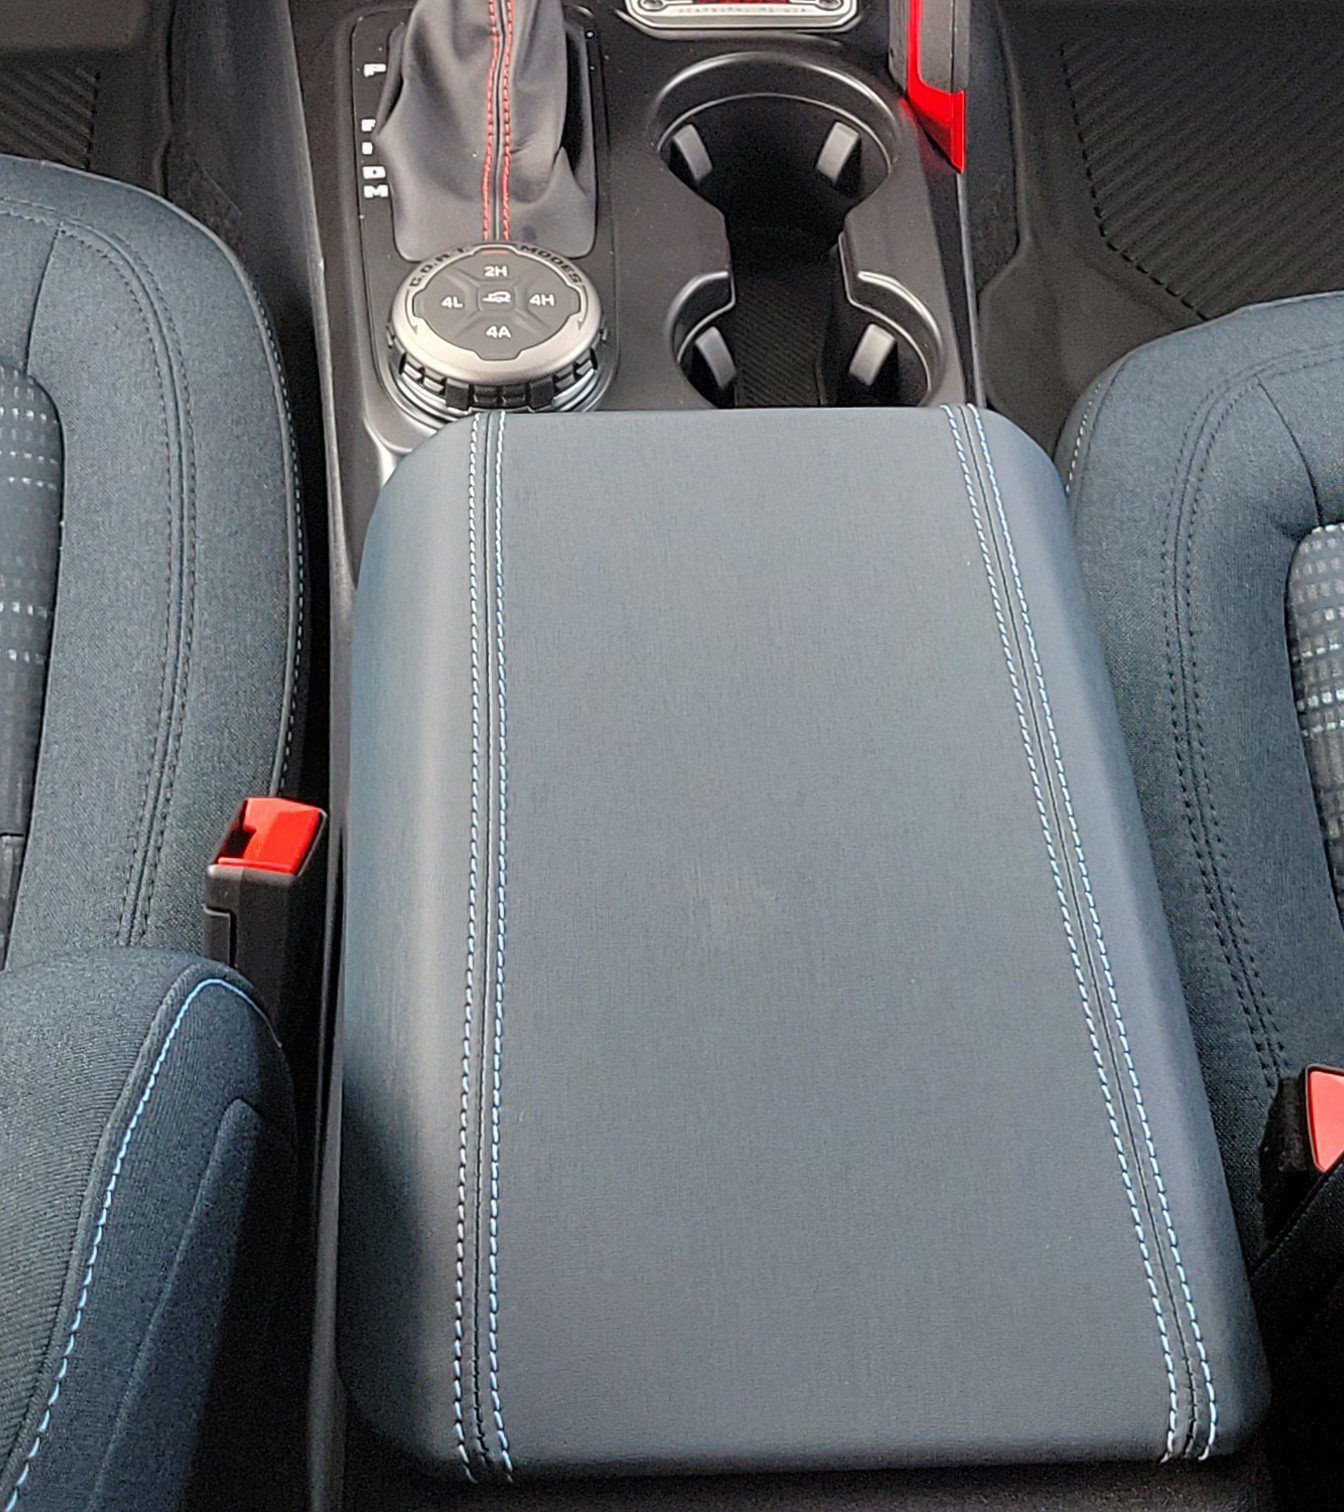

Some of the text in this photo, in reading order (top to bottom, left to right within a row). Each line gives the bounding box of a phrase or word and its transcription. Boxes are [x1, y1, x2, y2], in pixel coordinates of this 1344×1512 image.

[363, 184, 389, 198] M
[520, 244, 583, 285] MODES
[484, 265, 508, 278] 2H
[441, 296, 464, 308] 4L
[529, 294, 555, 307] 4H
[485, 325, 512, 339] 4A
